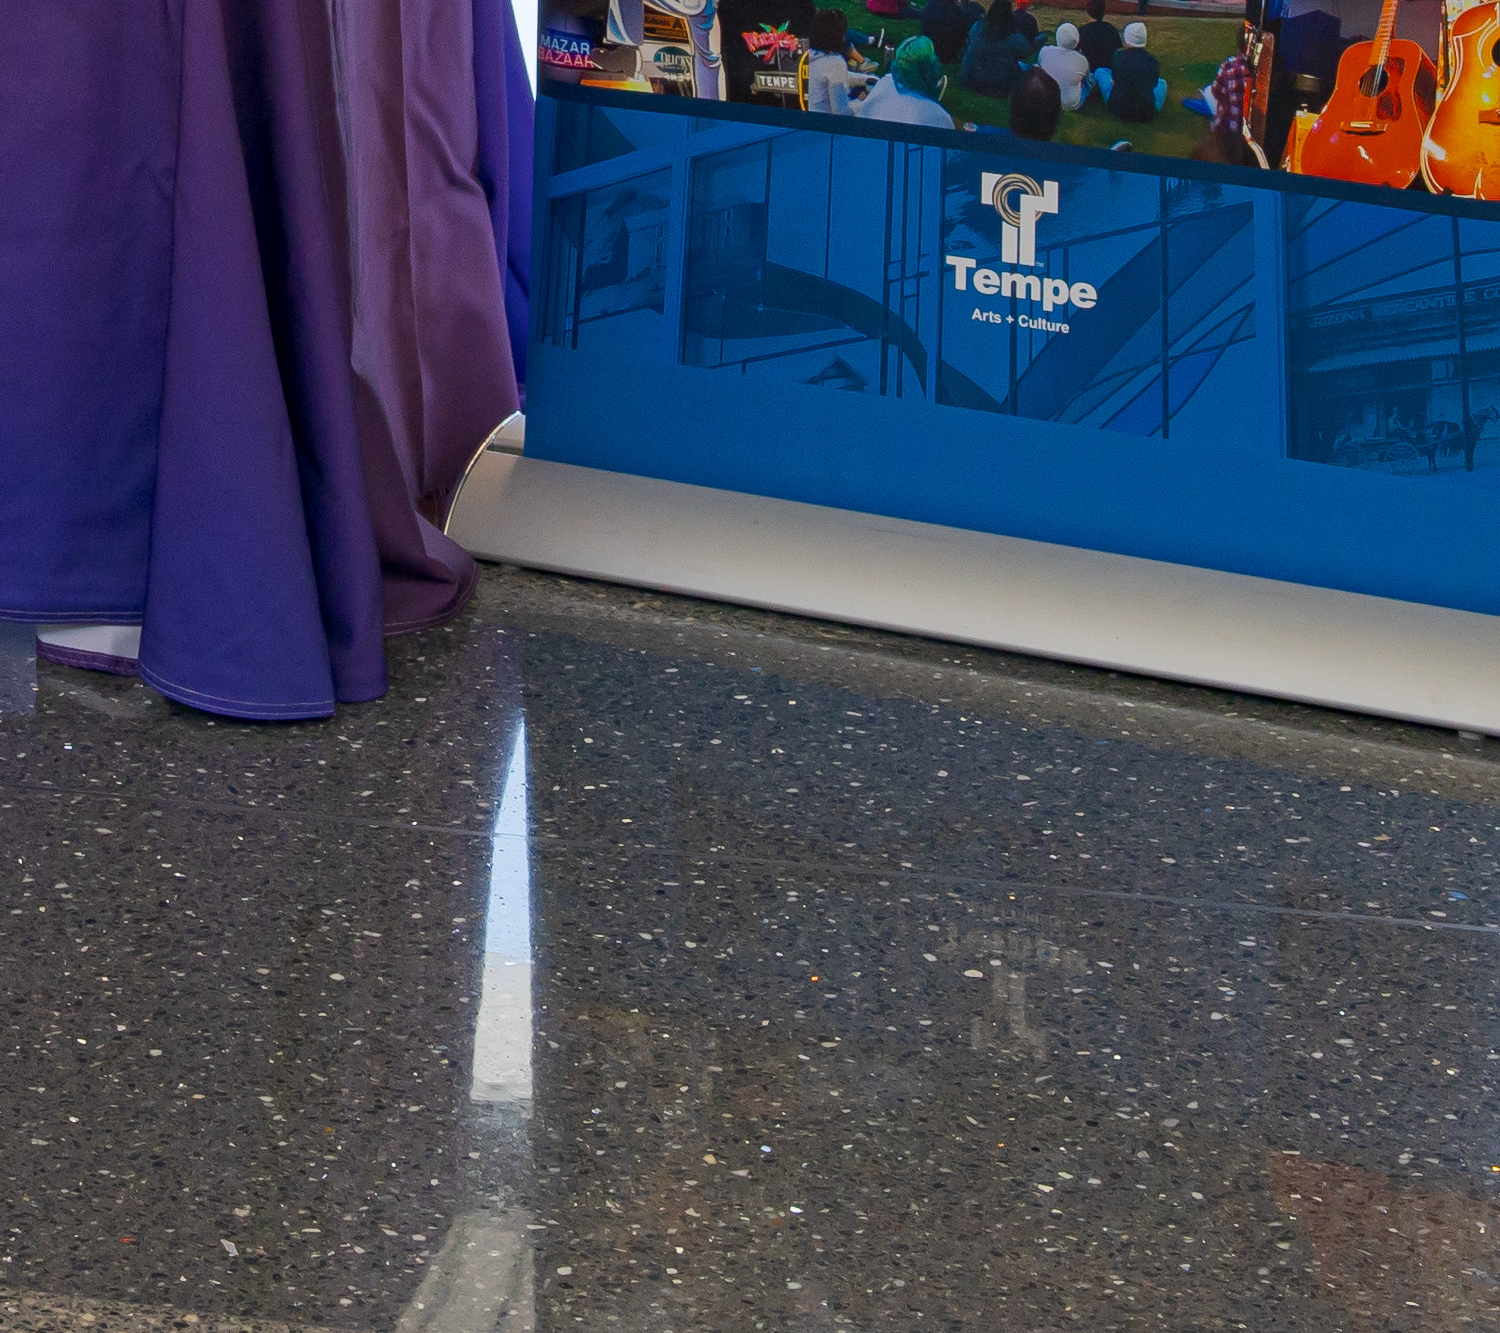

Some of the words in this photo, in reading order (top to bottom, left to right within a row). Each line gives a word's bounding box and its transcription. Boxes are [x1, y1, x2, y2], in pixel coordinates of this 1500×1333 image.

[759, 75, 795, 88] TEMPE
[946, 256, 1097, 313] Tempe
[971, 307, 1004, 327] Arts
[1018, 312, 1070, 335] Culture
